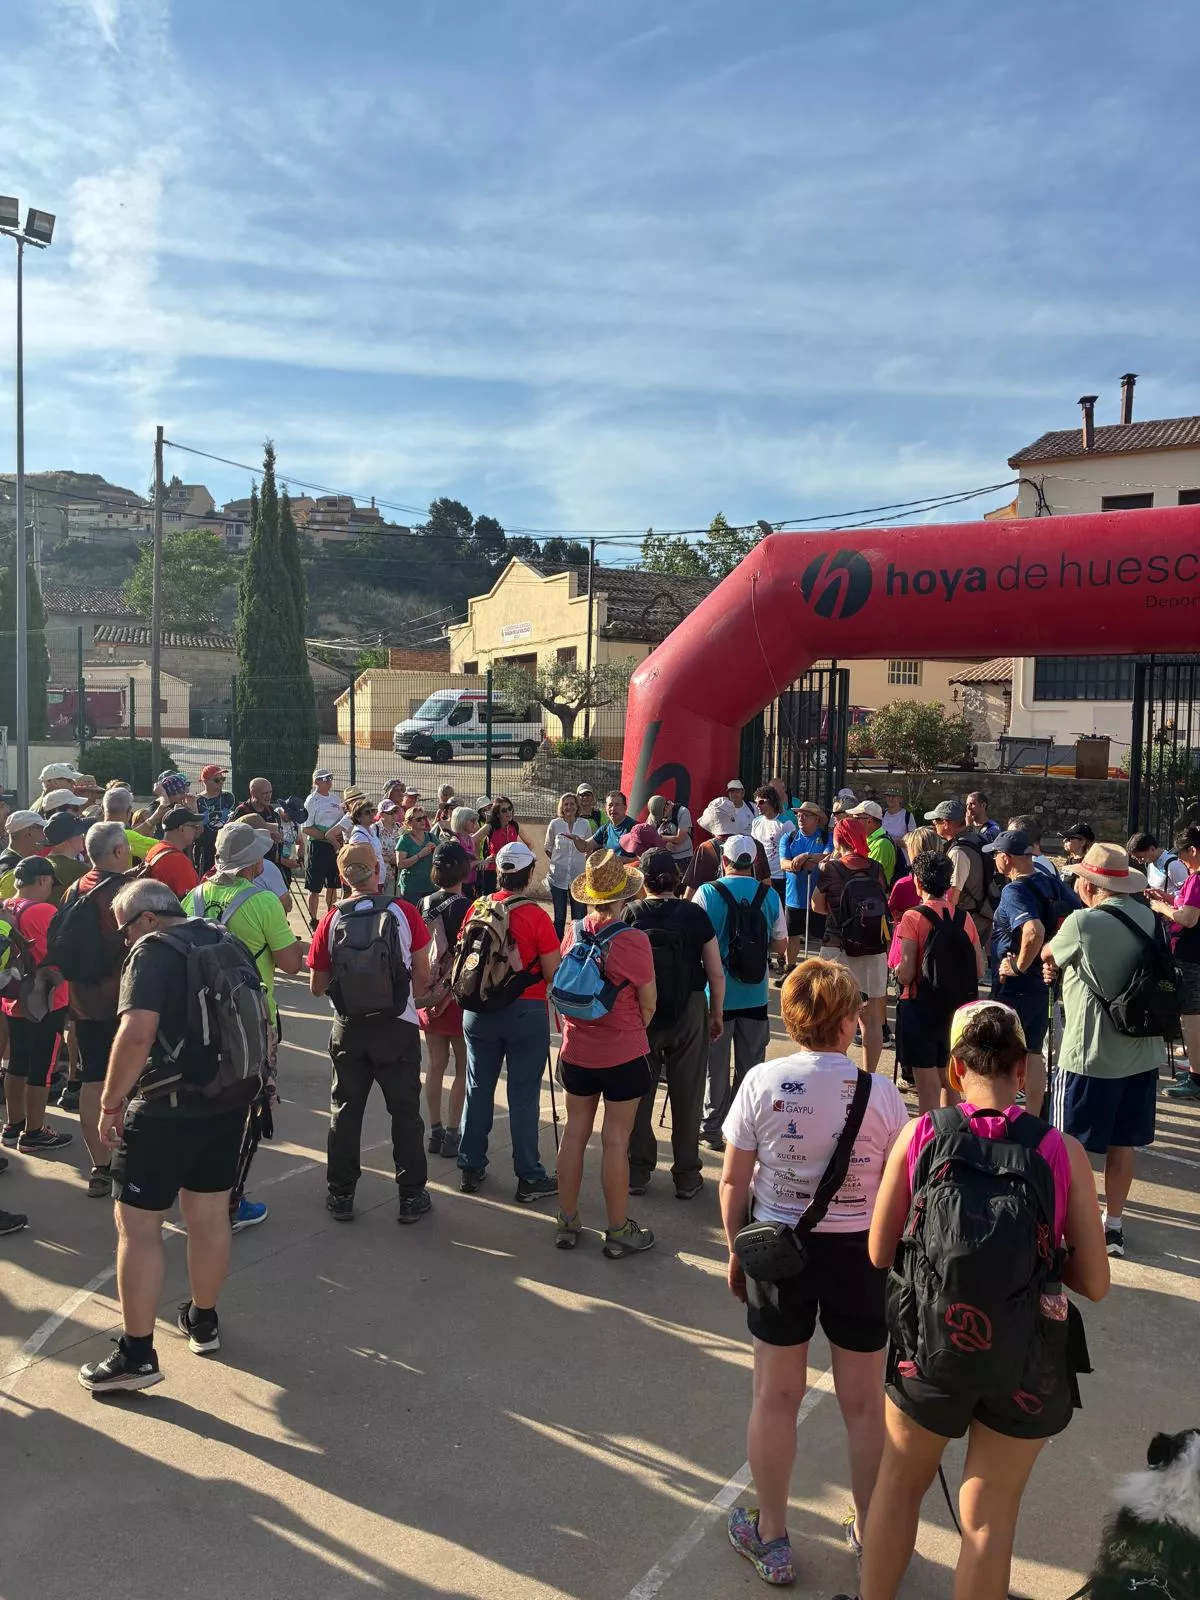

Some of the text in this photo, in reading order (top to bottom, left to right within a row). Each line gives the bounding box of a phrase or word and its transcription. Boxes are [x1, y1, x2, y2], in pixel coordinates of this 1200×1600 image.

[886, 563, 987, 602] hoya
[996, 554, 1049, 591] de
[786, 1106, 814, 1114] GAYPU
